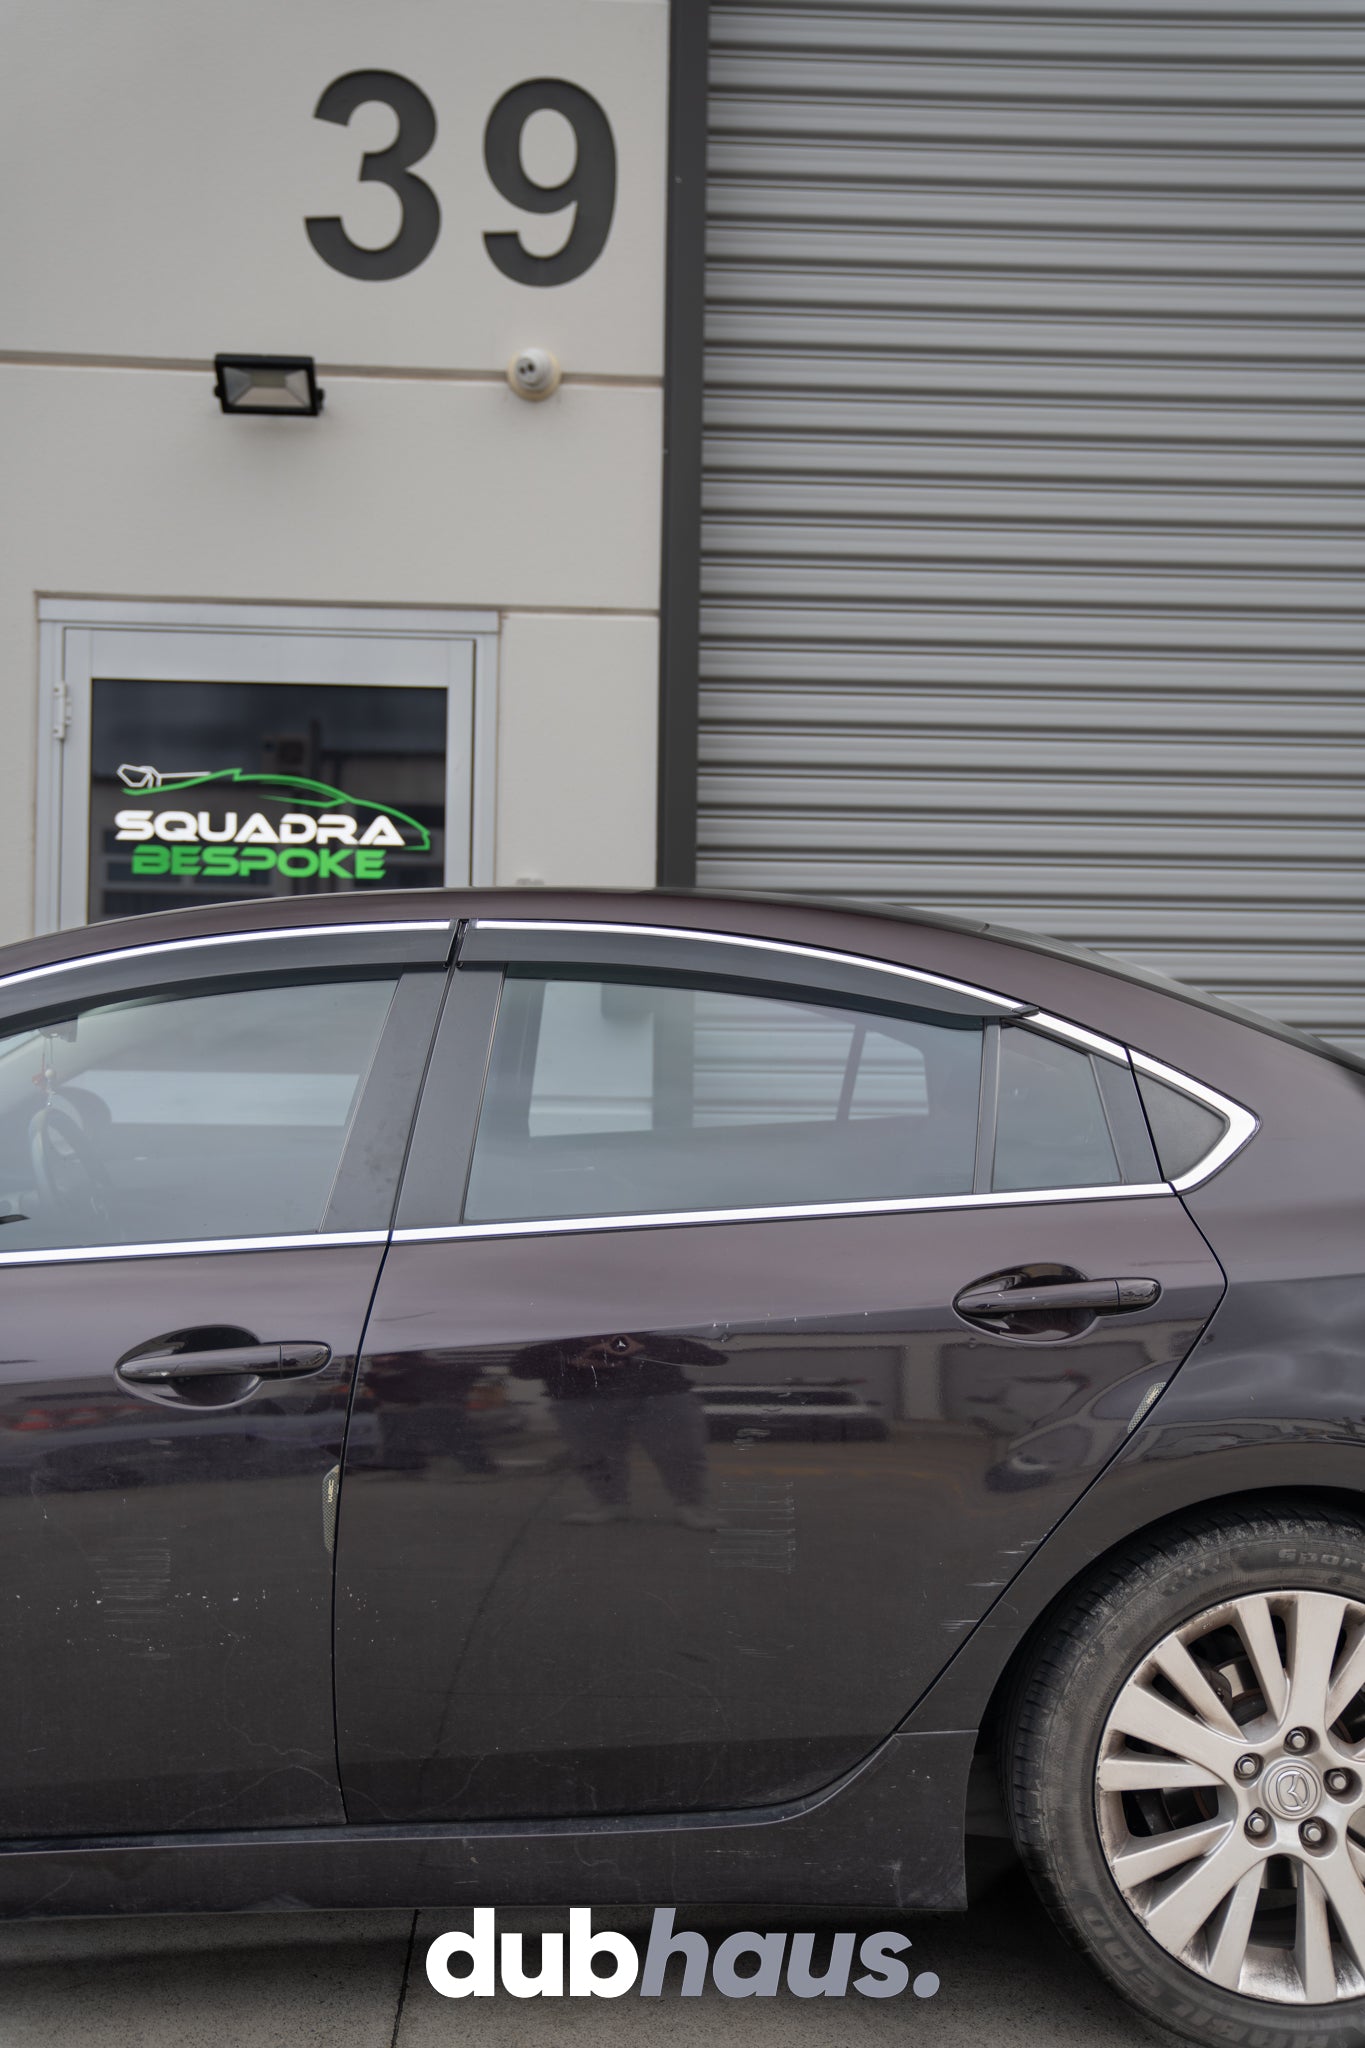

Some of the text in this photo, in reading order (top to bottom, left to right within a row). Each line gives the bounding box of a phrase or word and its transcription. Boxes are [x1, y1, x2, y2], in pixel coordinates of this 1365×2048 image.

[304, 68, 618, 287] 39
[114, 809, 406, 847] SQUADRA
[131, 843, 386, 880] BESPOKE
